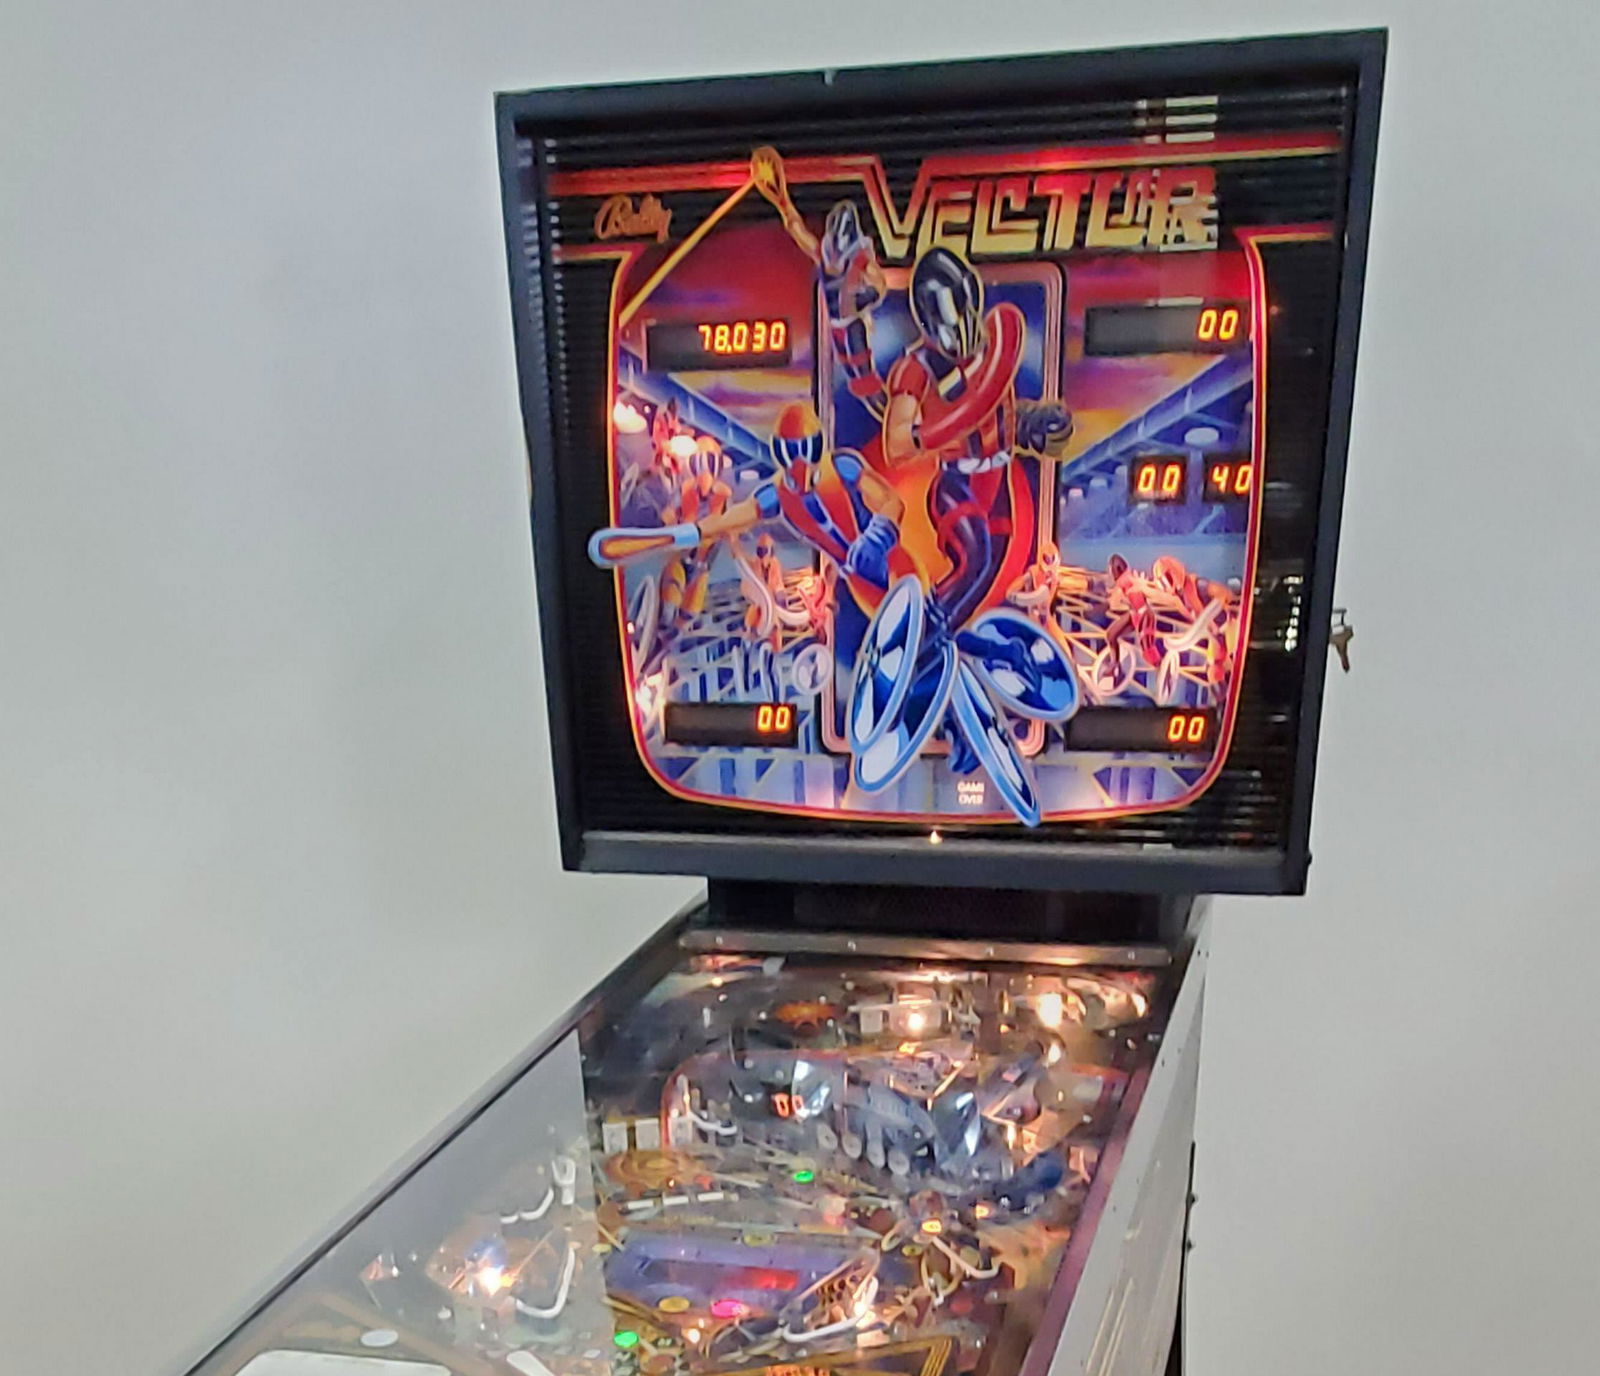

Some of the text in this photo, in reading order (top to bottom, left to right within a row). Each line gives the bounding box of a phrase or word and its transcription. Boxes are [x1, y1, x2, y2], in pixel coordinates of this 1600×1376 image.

[866, 158, 1216, 259] VECTOR
[1198, 309, 1239, 341] 00
[1137, 463, 1253, 495] 00 40
[757, 705, 791, 731] 00
[1168, 715, 1205, 742] 00
